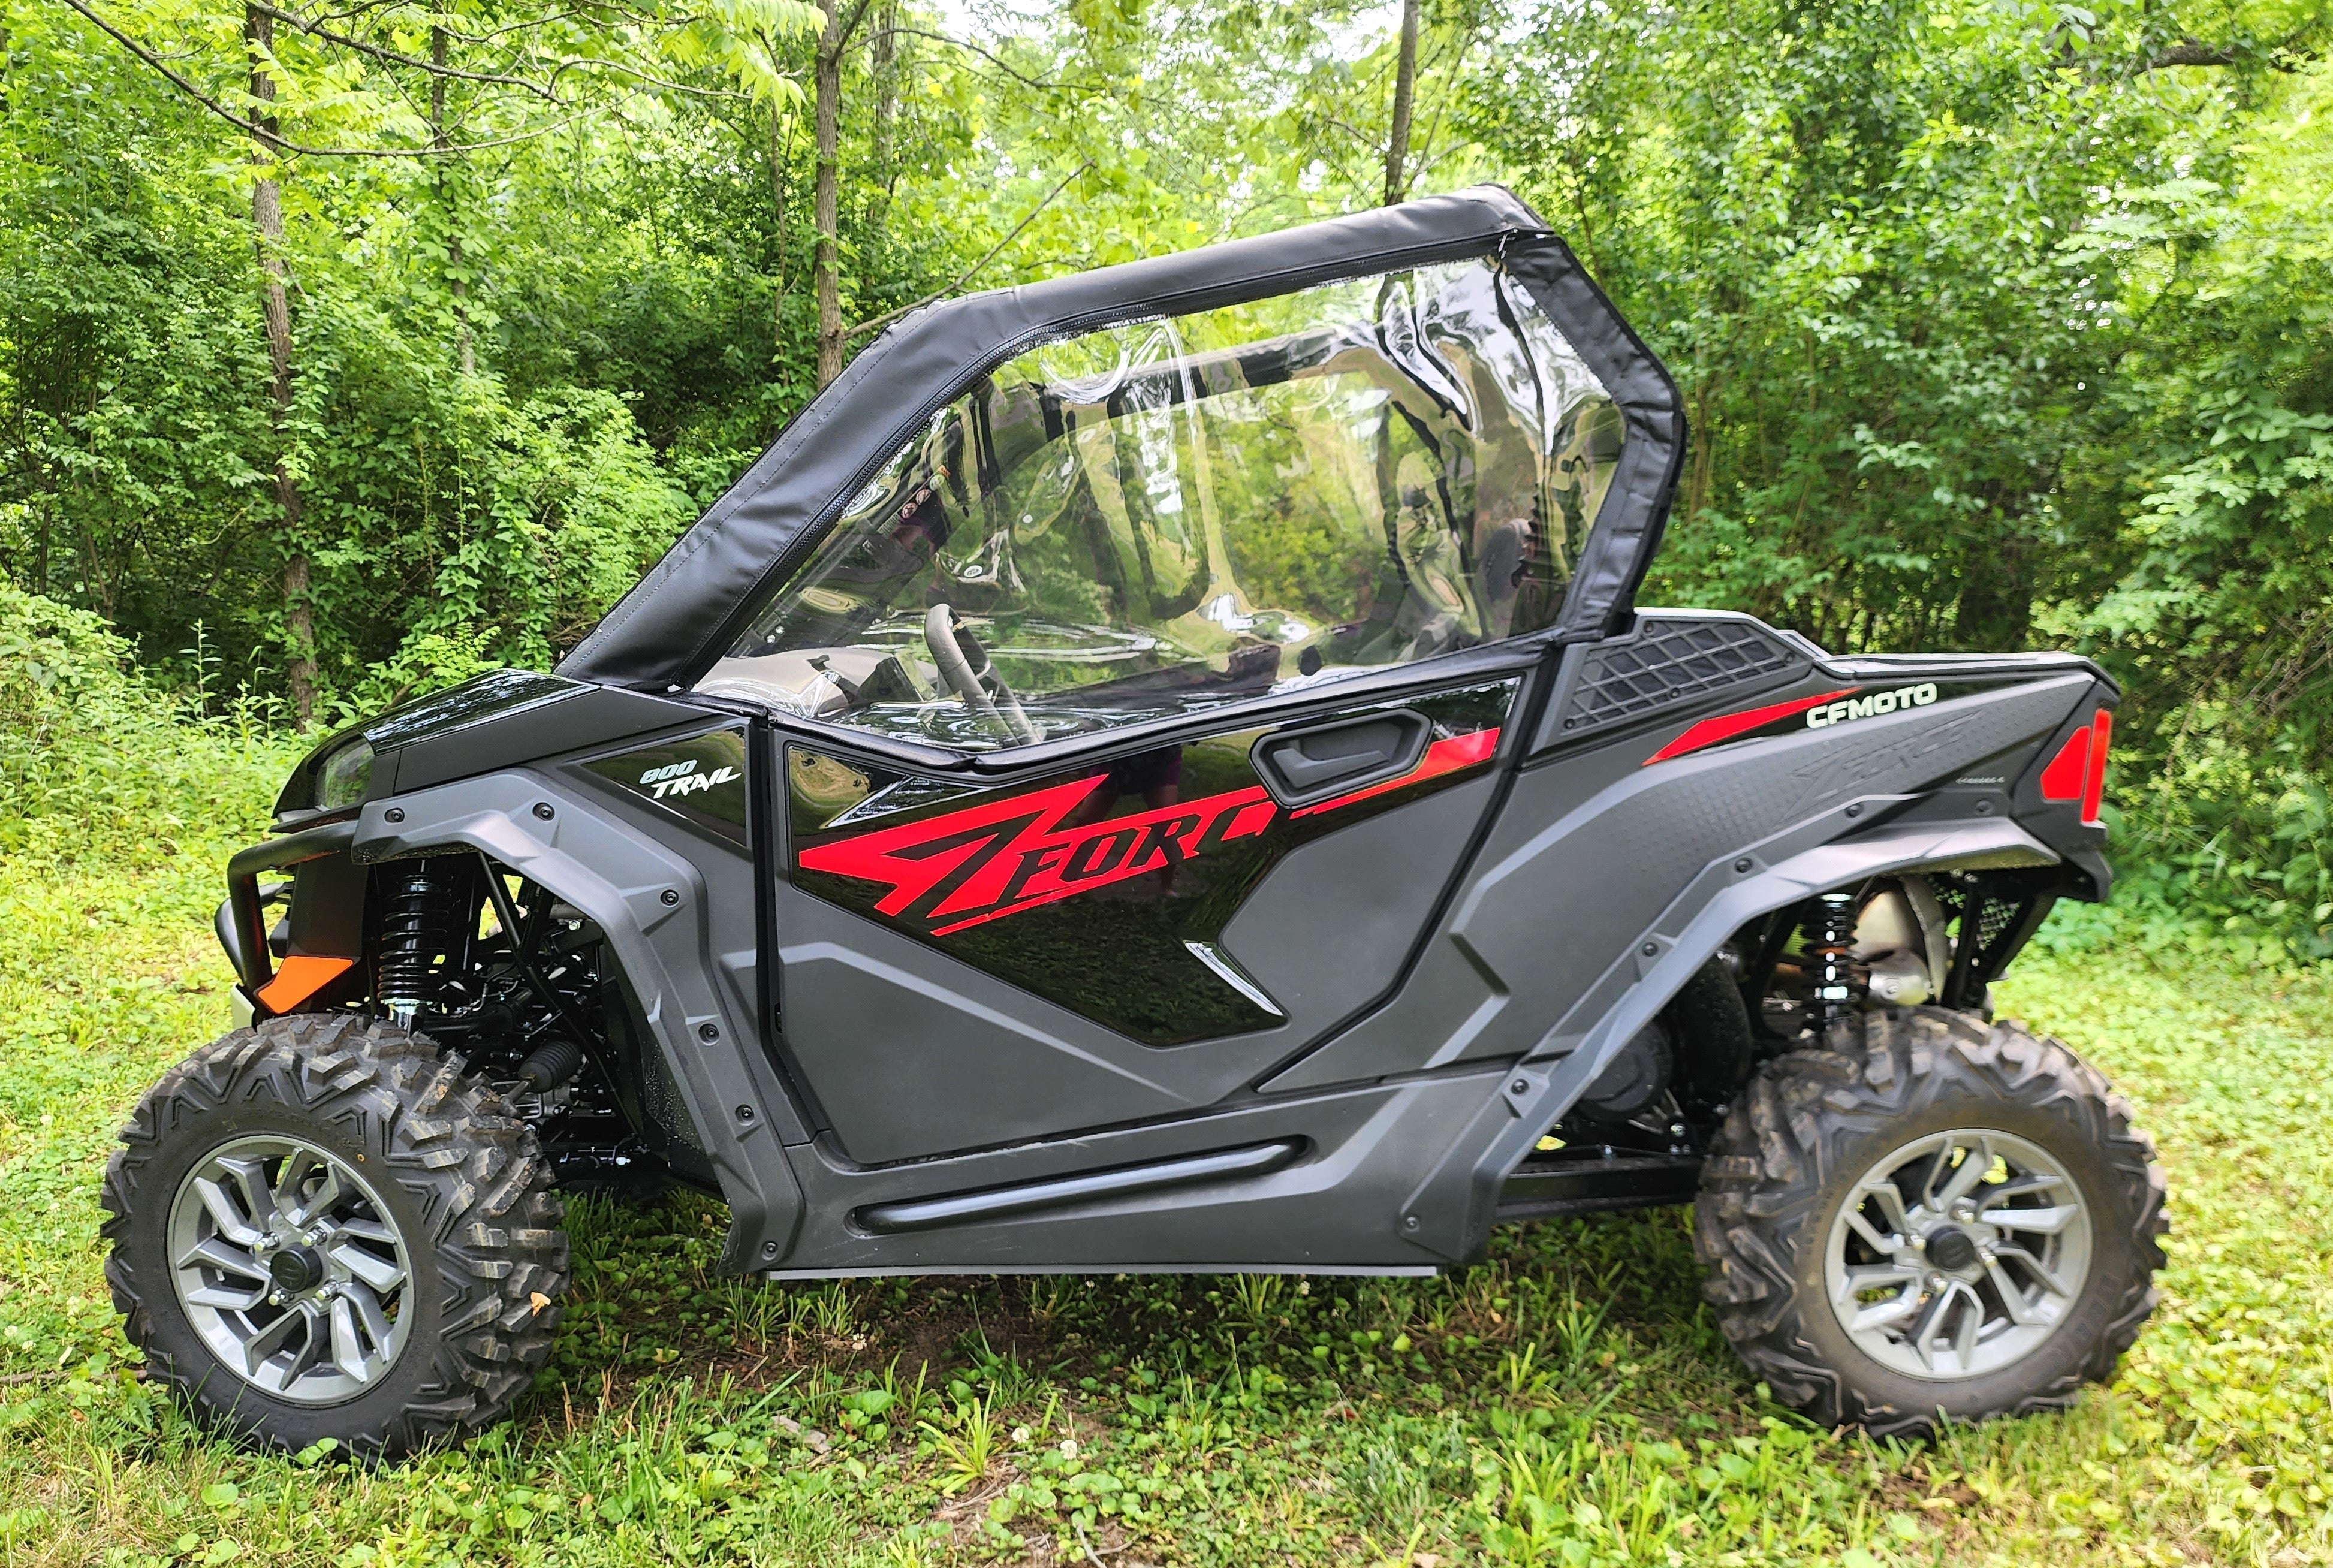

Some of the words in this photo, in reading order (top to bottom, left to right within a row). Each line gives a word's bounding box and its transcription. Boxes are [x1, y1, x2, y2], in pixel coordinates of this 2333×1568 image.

[1806, 682, 1937, 729] CFMOTO
[639, 759, 698, 785] 800
[650, 765, 742, 800] TRAIL
